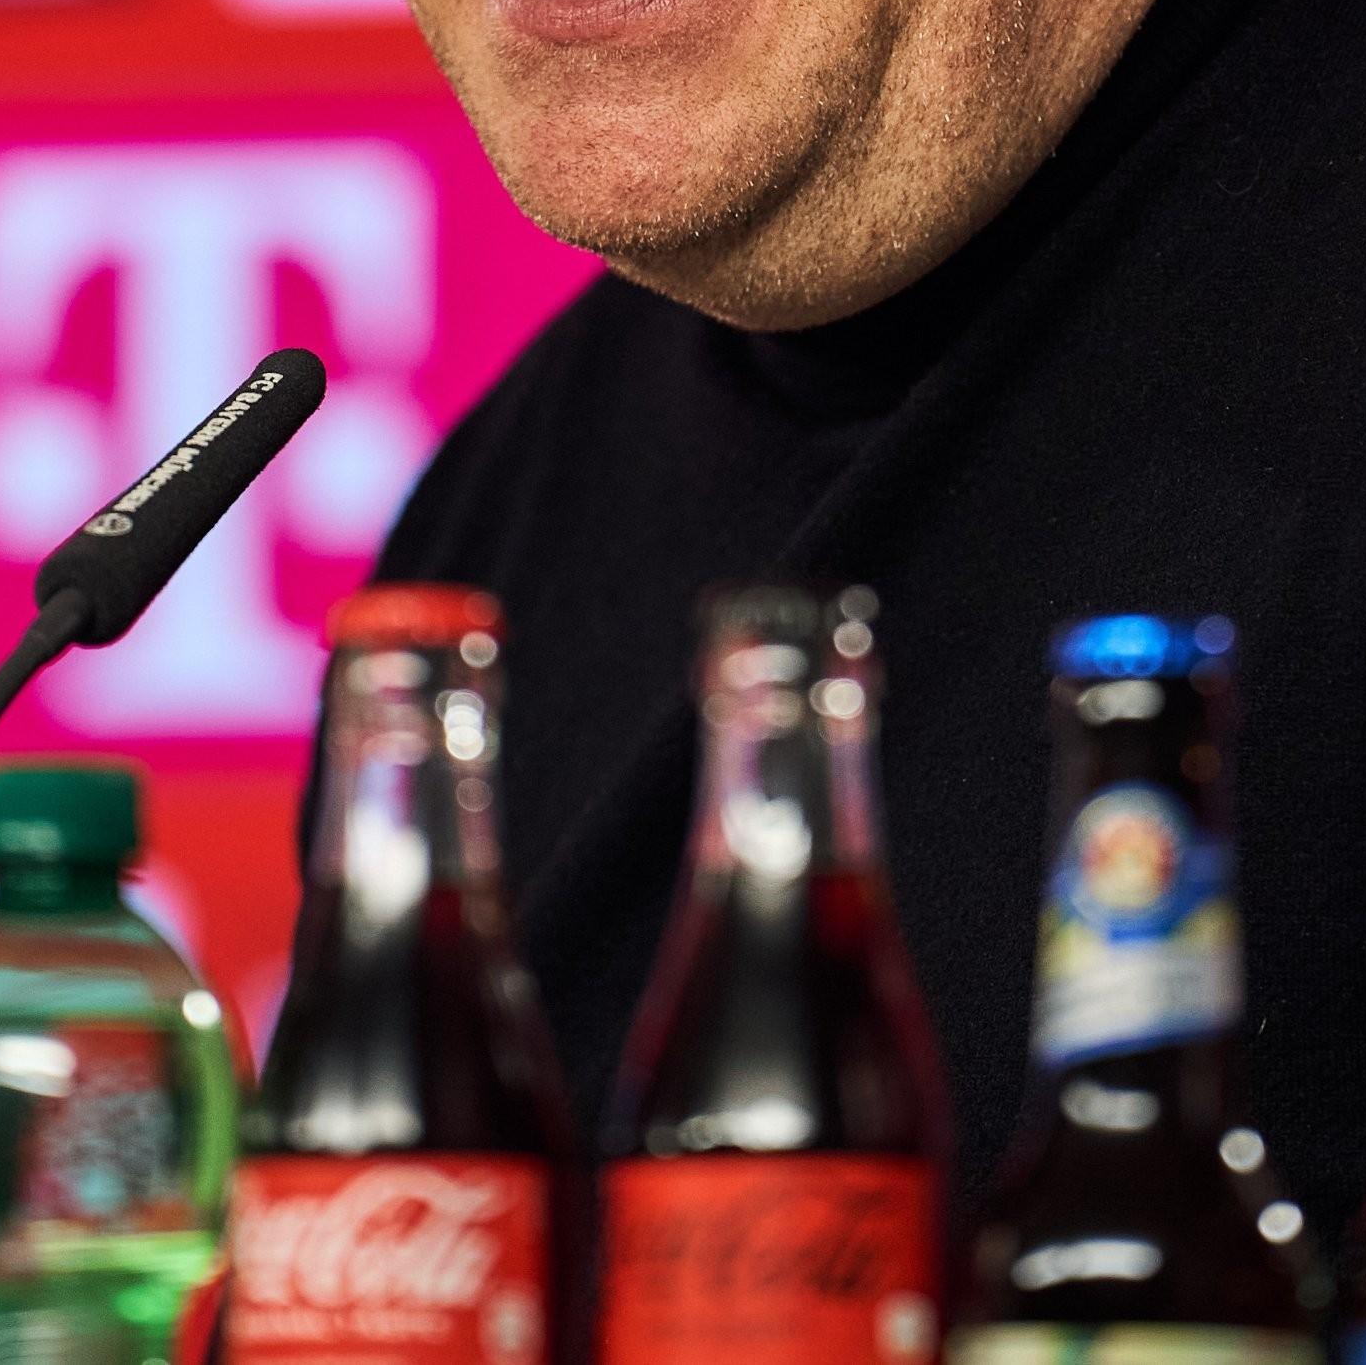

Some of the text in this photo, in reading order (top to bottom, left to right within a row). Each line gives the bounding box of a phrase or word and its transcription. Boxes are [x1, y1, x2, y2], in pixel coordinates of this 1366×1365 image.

[113, 372, 283, 512] FC BAYERN MÜNCHEN
